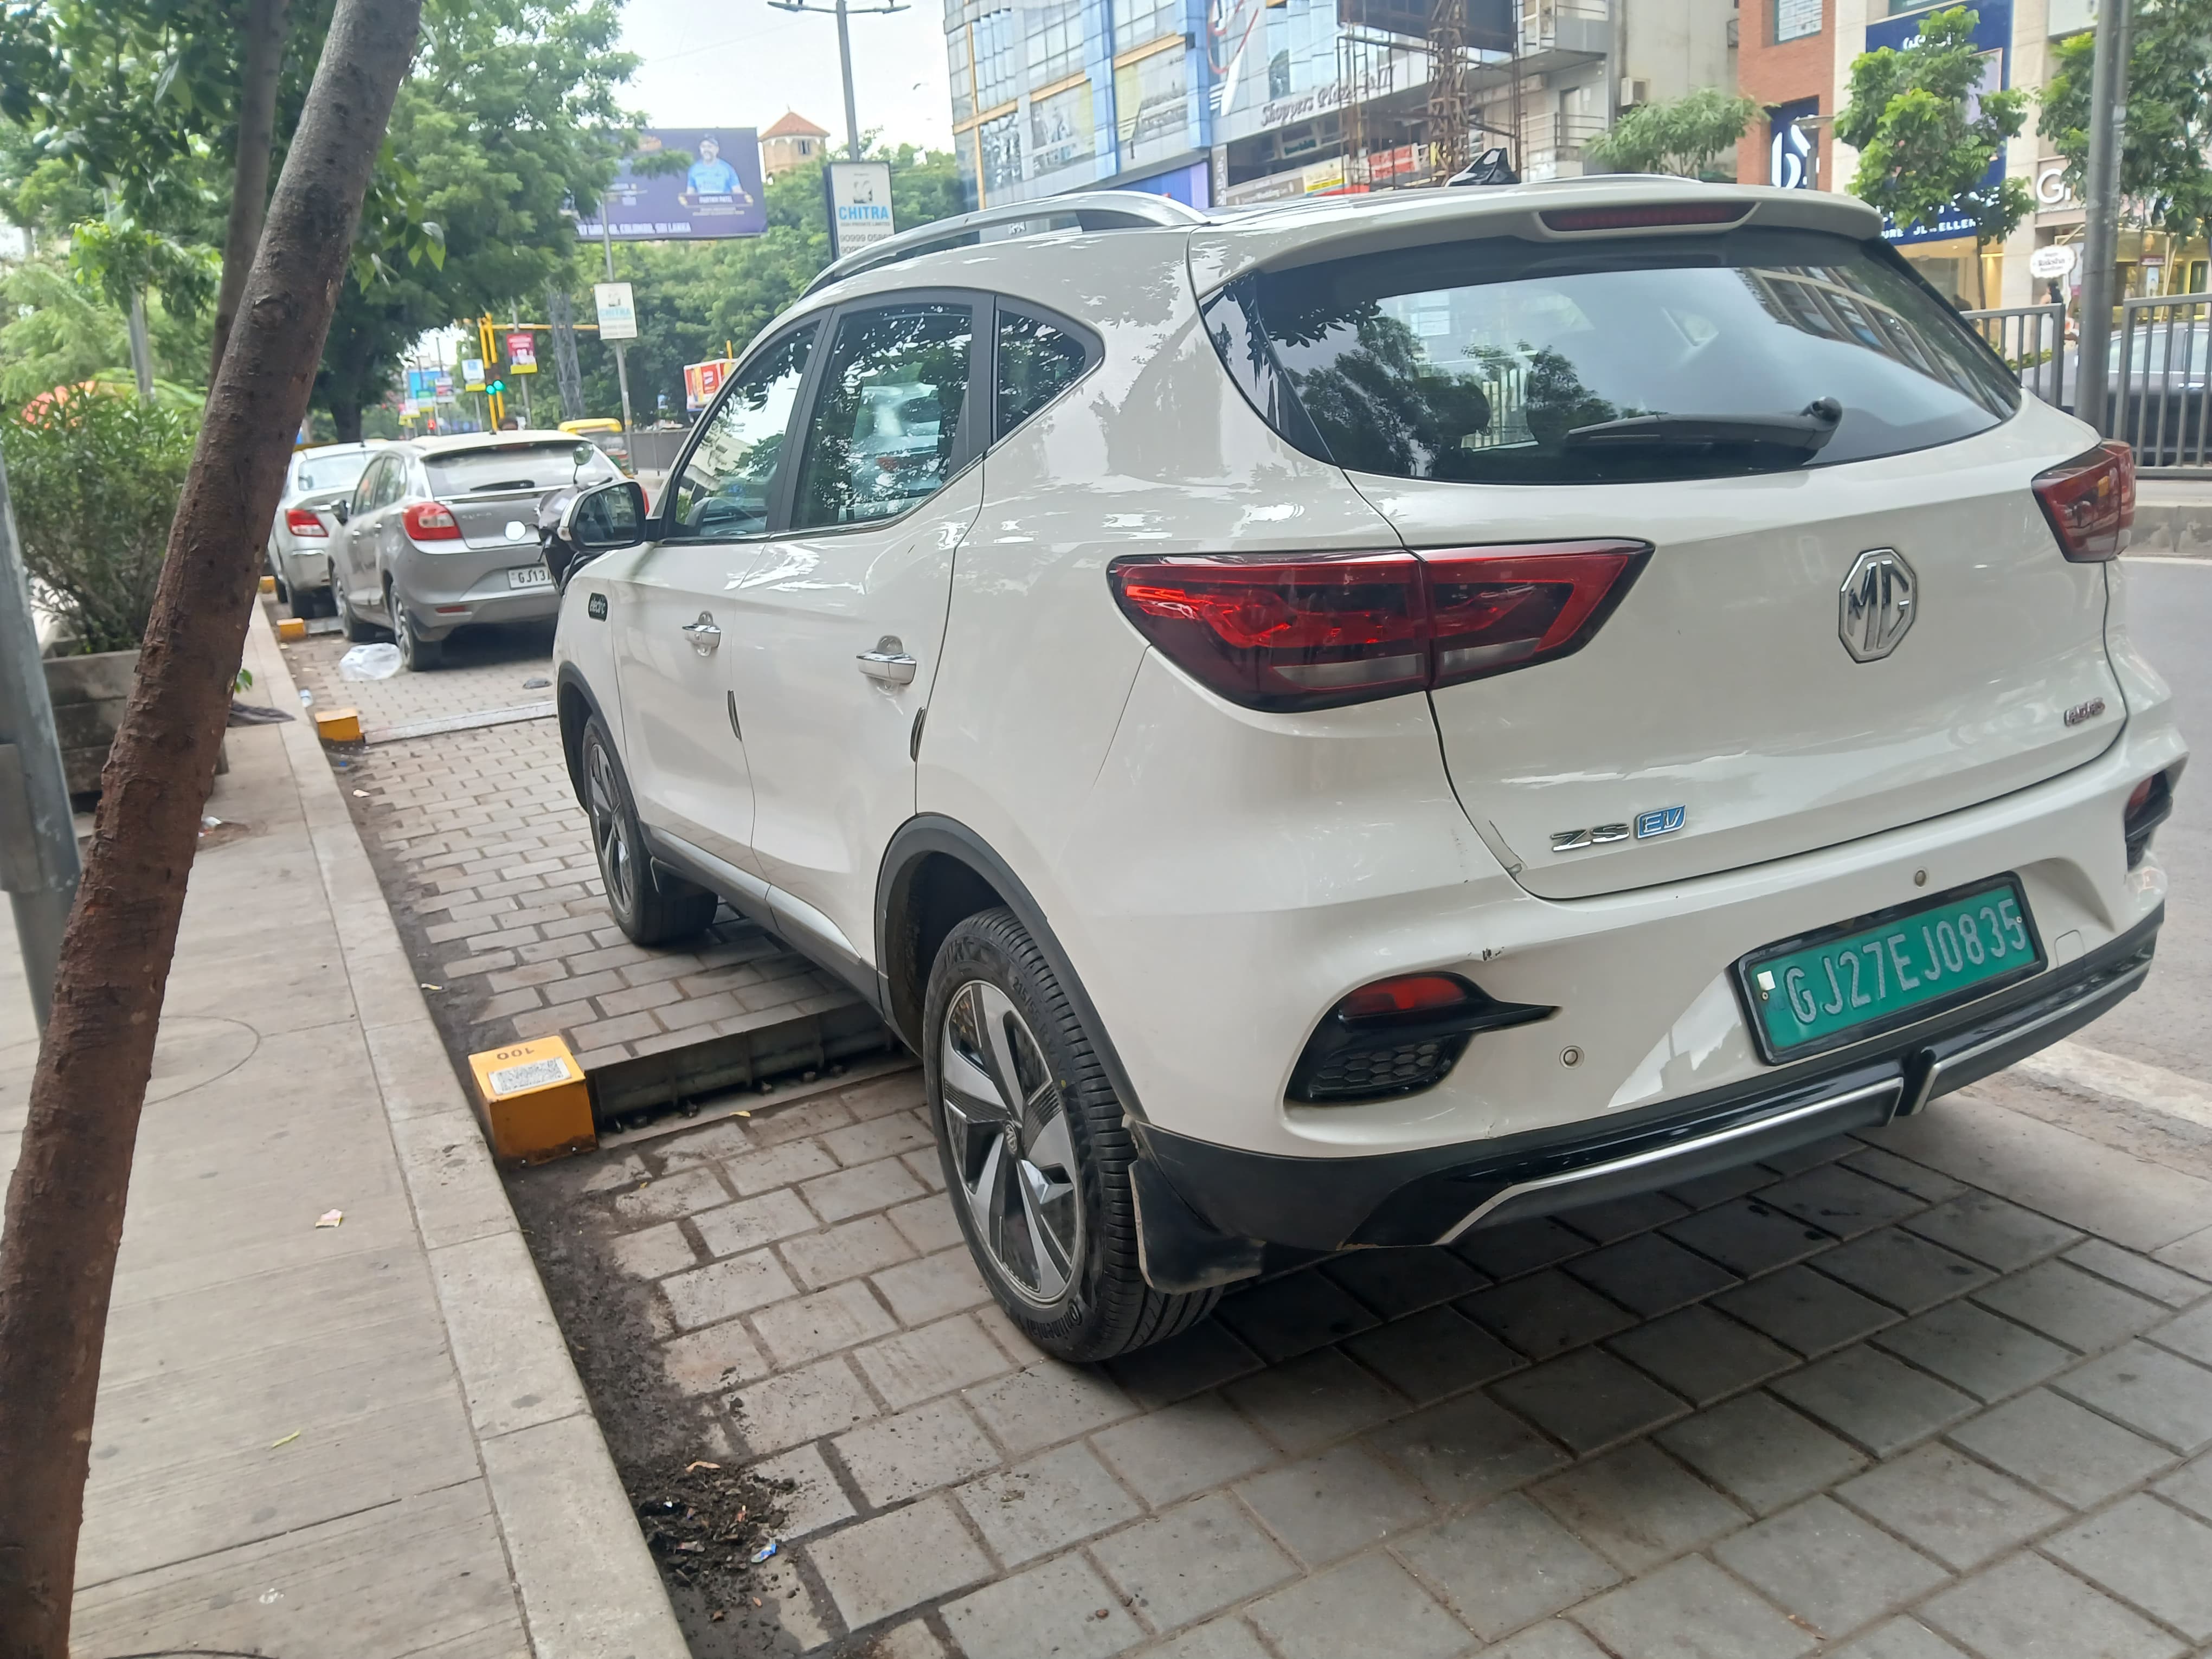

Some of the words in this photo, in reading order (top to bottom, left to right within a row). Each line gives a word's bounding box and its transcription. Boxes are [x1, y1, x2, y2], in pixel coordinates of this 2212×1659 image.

[1261, 97, 1314, 126] Shoppers
[839, 206, 889, 220] CHITRA
[1844, 556, 1912, 654] MG
[1549, 823, 1630, 852] ZS
[1641, 808, 1683, 834] EV
[1786, 898, 2026, 1025] GJ27EJ0835
